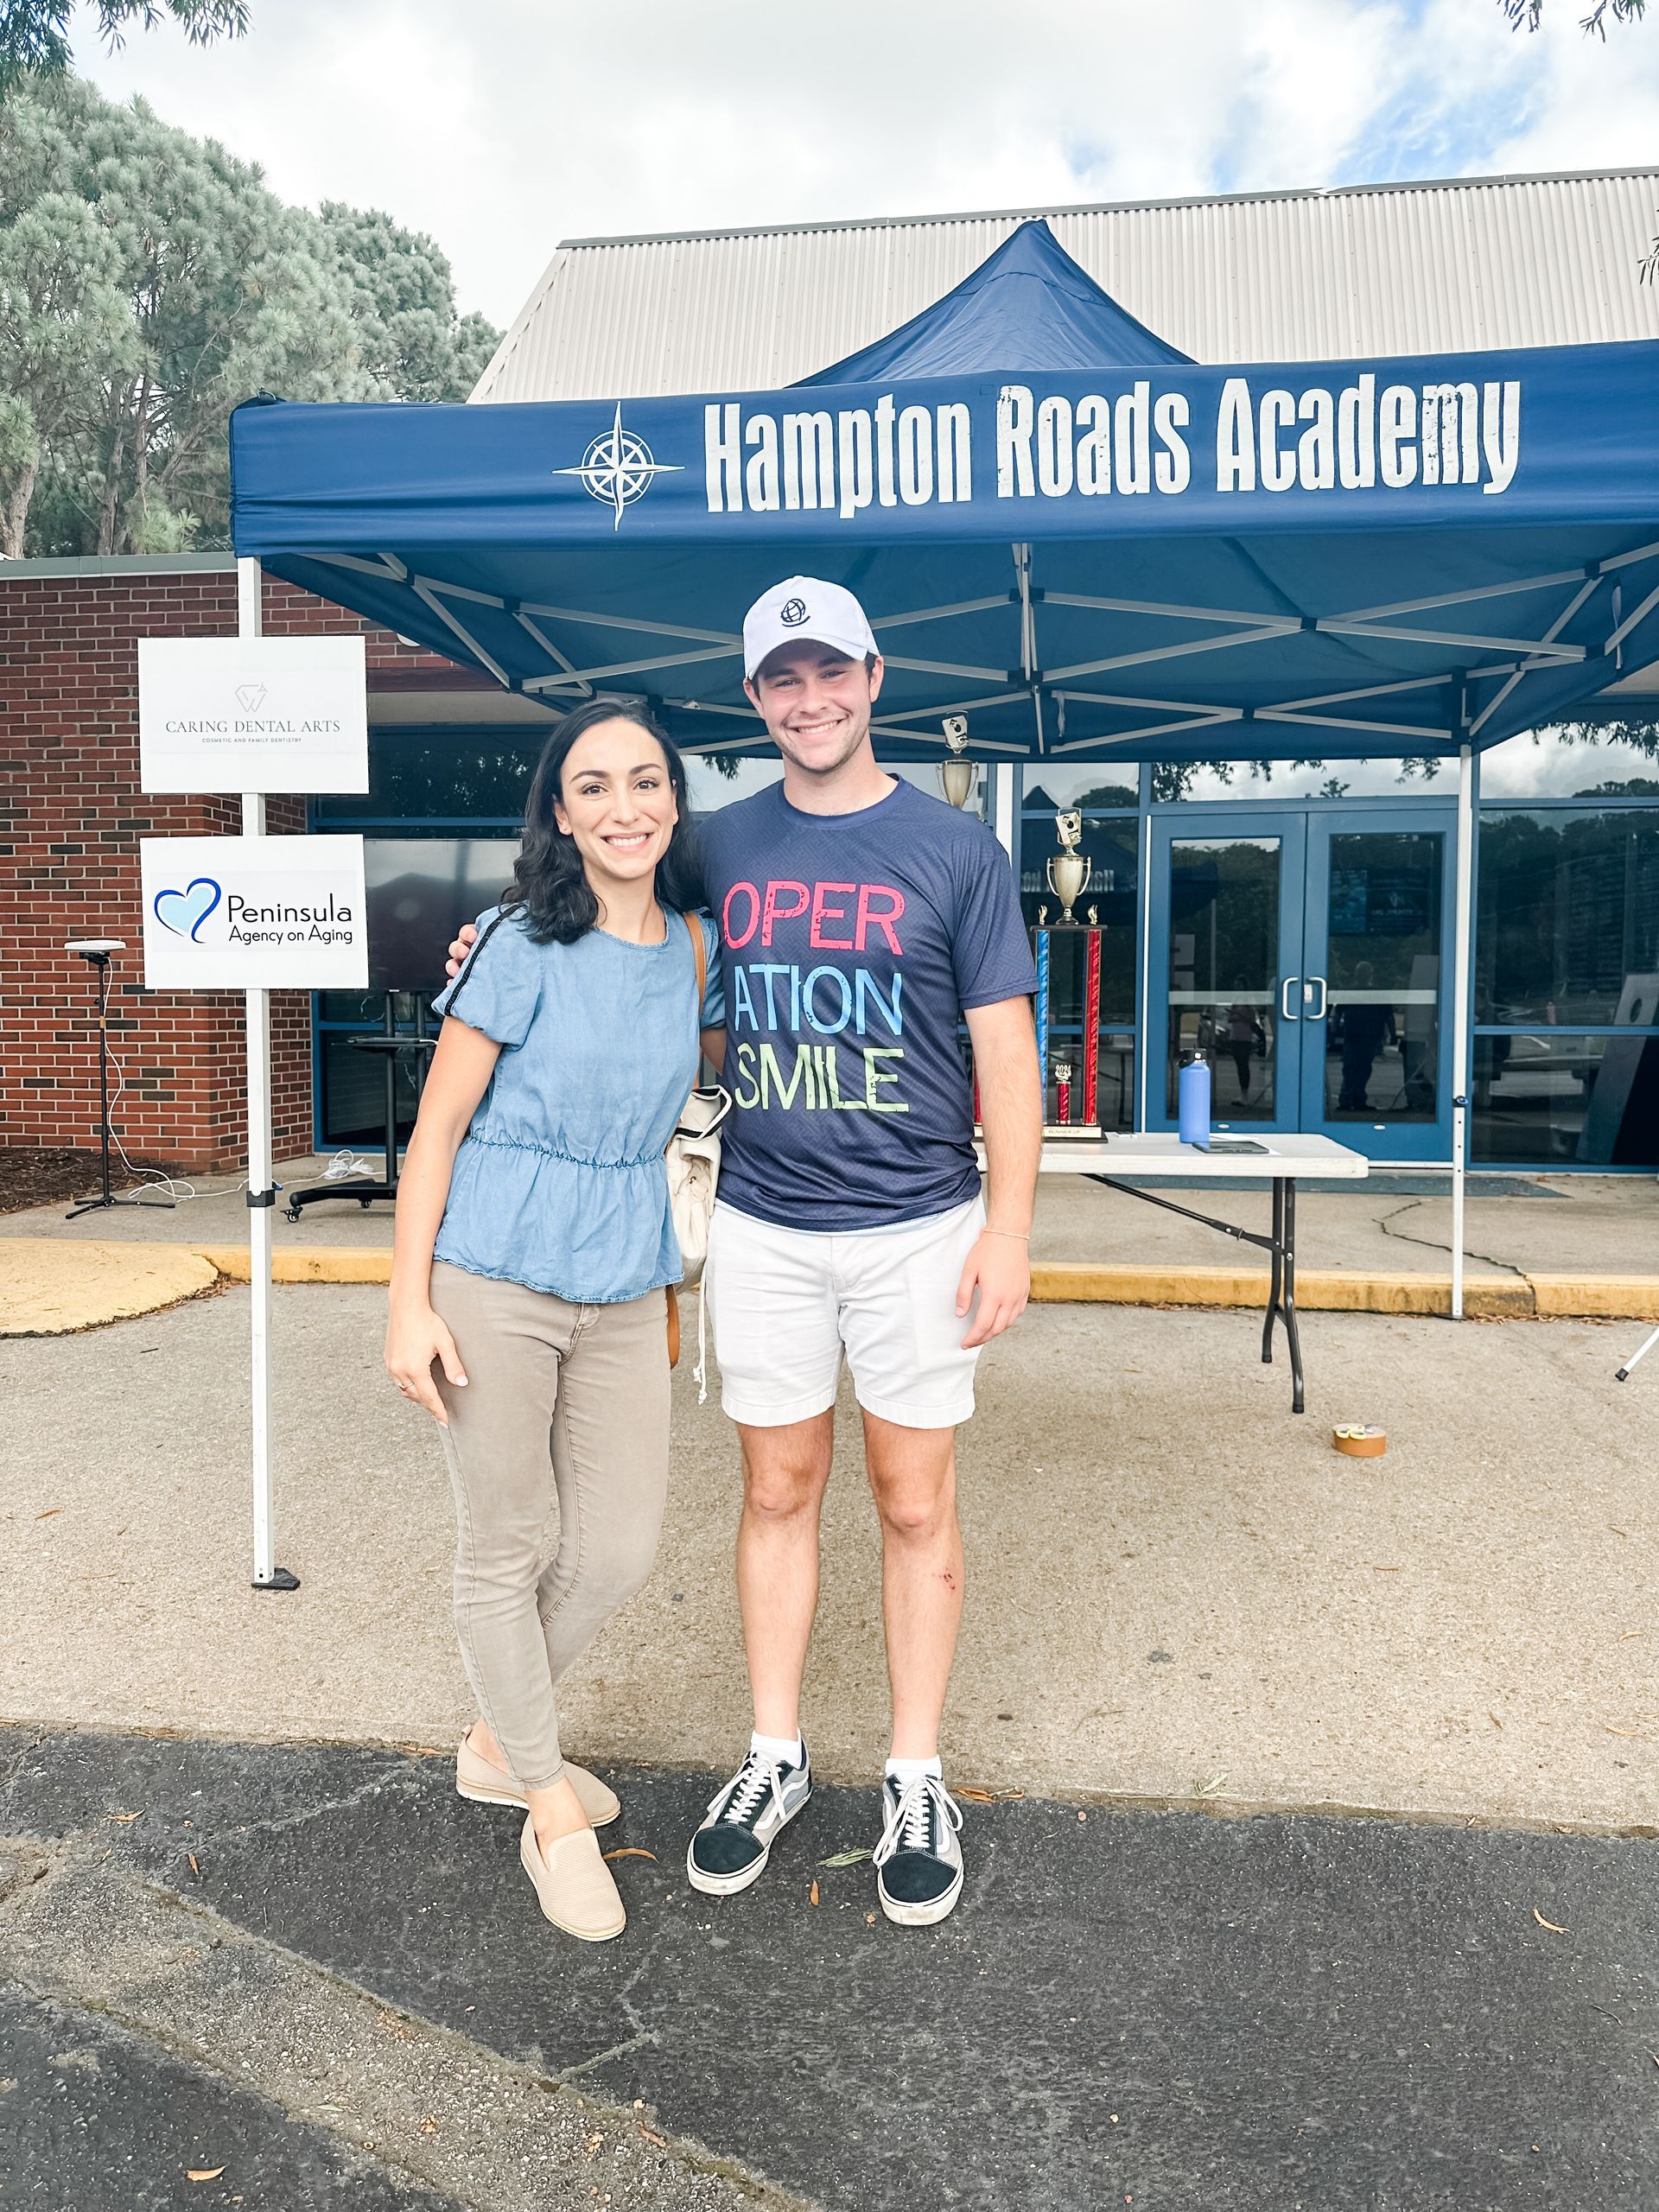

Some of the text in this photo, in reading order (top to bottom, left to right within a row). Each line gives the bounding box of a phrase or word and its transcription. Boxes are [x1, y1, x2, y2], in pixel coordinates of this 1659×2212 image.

[705, 373, 1521, 519] Hampton Roads Academy
[165, 720, 340, 733] CARING DENTAL ARTS
[227, 893, 353, 923] Peninsula
[722, 880, 906, 956] OPER
[228, 925, 353, 945] Agency on Aging
[734, 963, 902, 1036] ATION
[734, 1042, 910, 1113] SMILE
[1055, 1064, 1071, 1076] 2024
